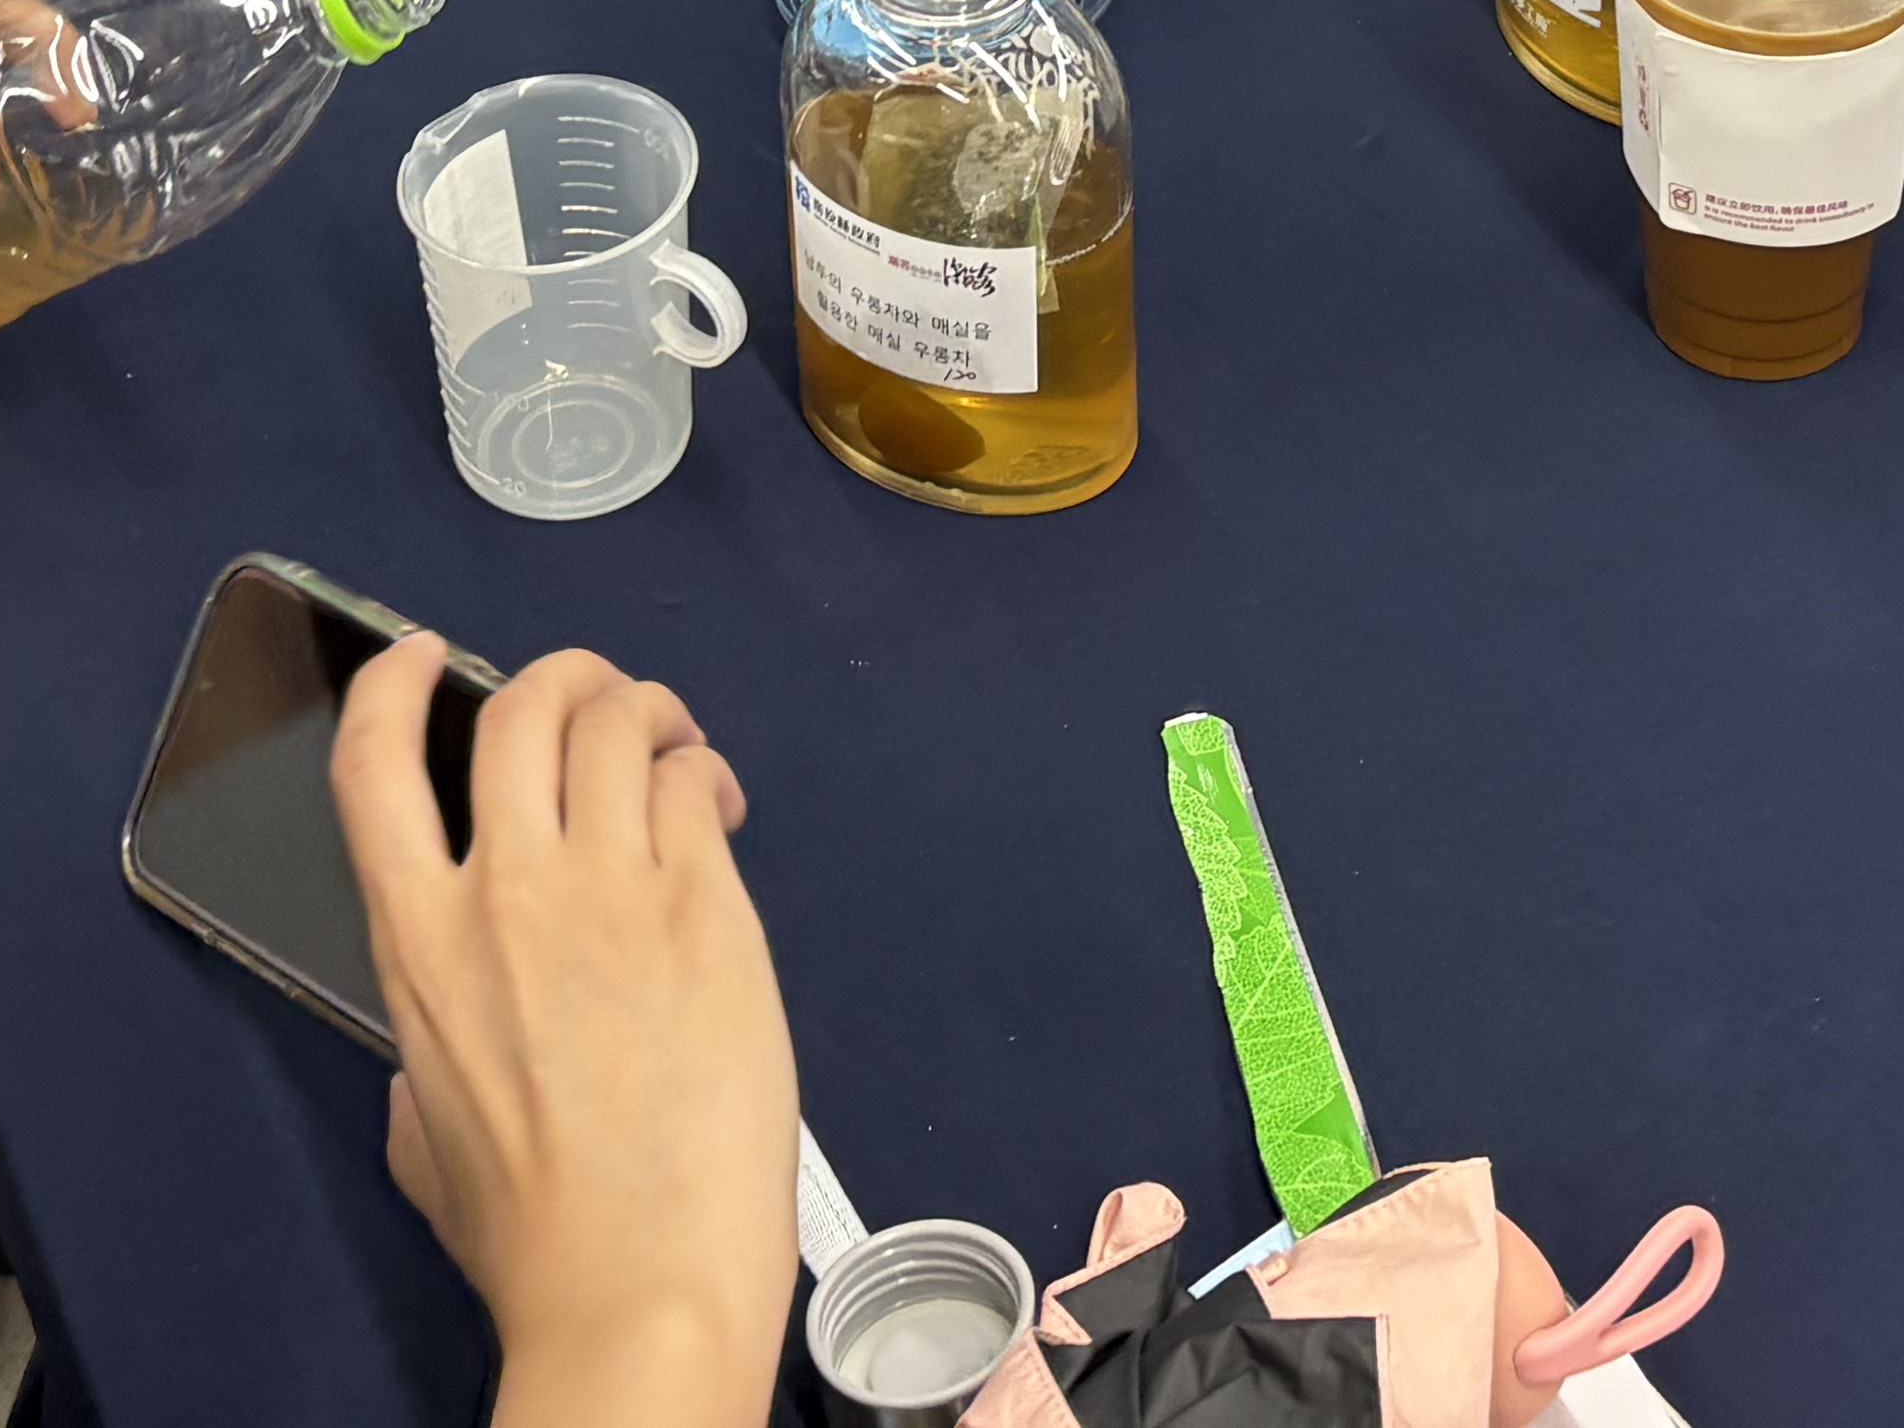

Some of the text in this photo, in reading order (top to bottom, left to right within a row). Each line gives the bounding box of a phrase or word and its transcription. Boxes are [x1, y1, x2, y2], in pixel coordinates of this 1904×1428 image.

[851, 285, 921, 329] 우롱차와
[932, 316, 992, 341] 매실을
[868, 324, 901, 352] 매실
[914, 340, 970, 368] 우롱차
